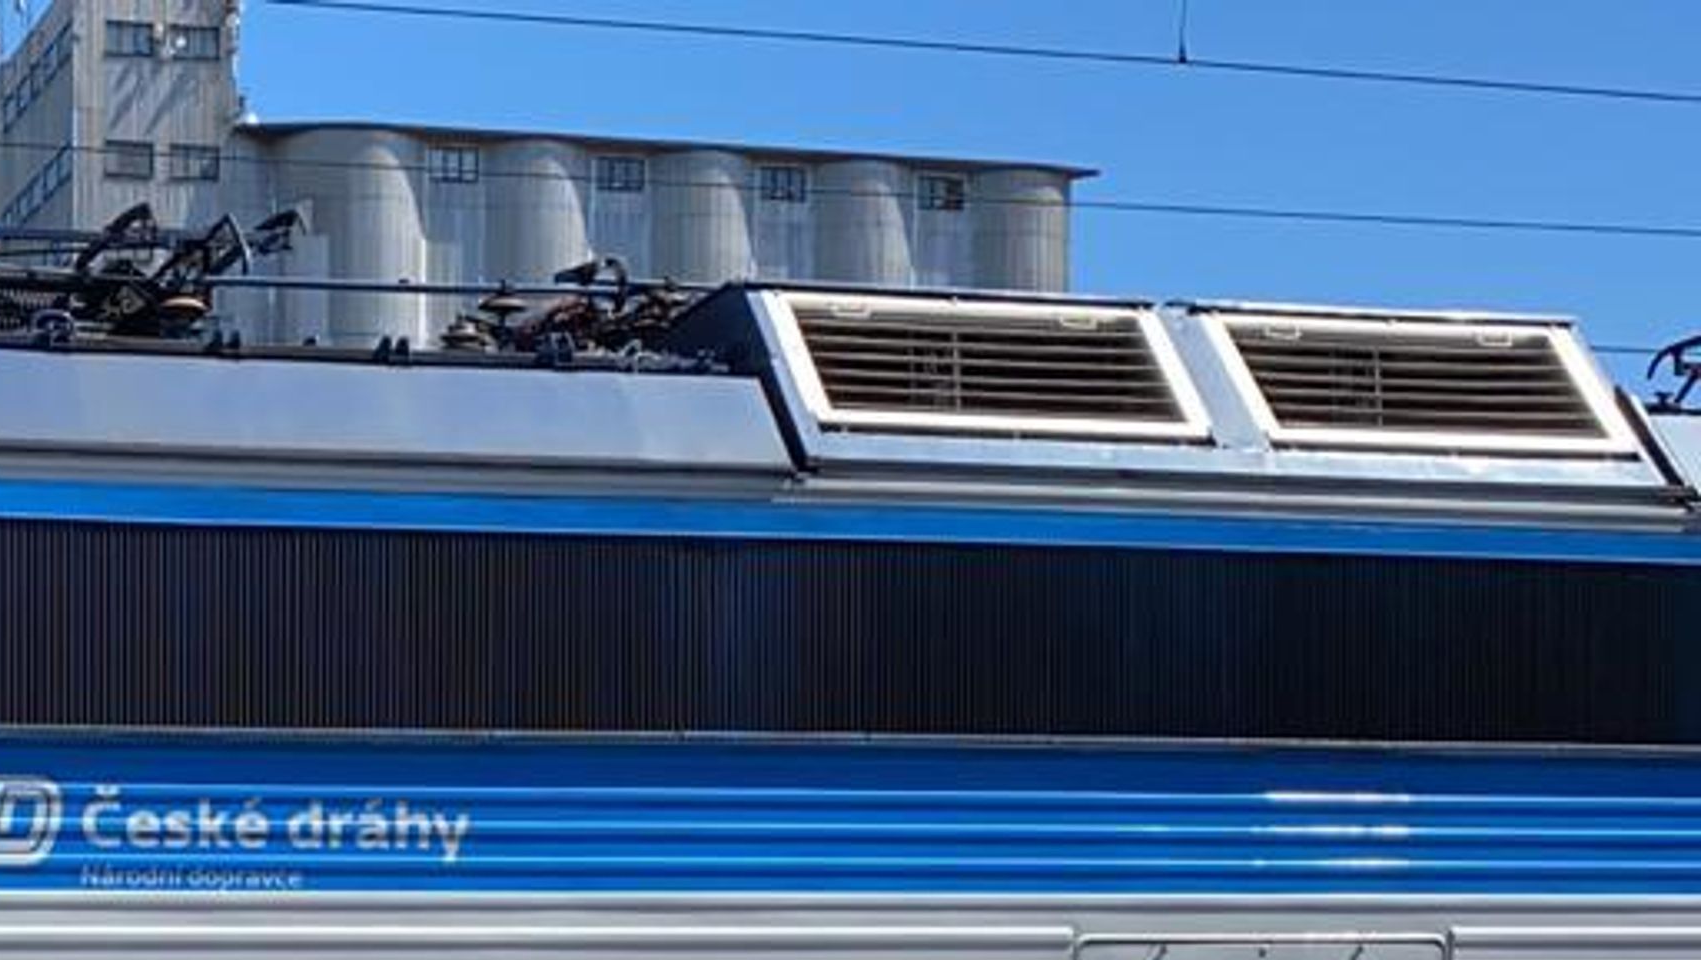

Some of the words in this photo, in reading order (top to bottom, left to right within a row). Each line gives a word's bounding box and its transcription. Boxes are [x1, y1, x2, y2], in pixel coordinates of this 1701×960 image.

[81, 783, 269, 849] České
[287, 796, 471, 862] dráhy
[80, 863, 182, 887] Národní
[186, 866, 304, 895] dopravce
